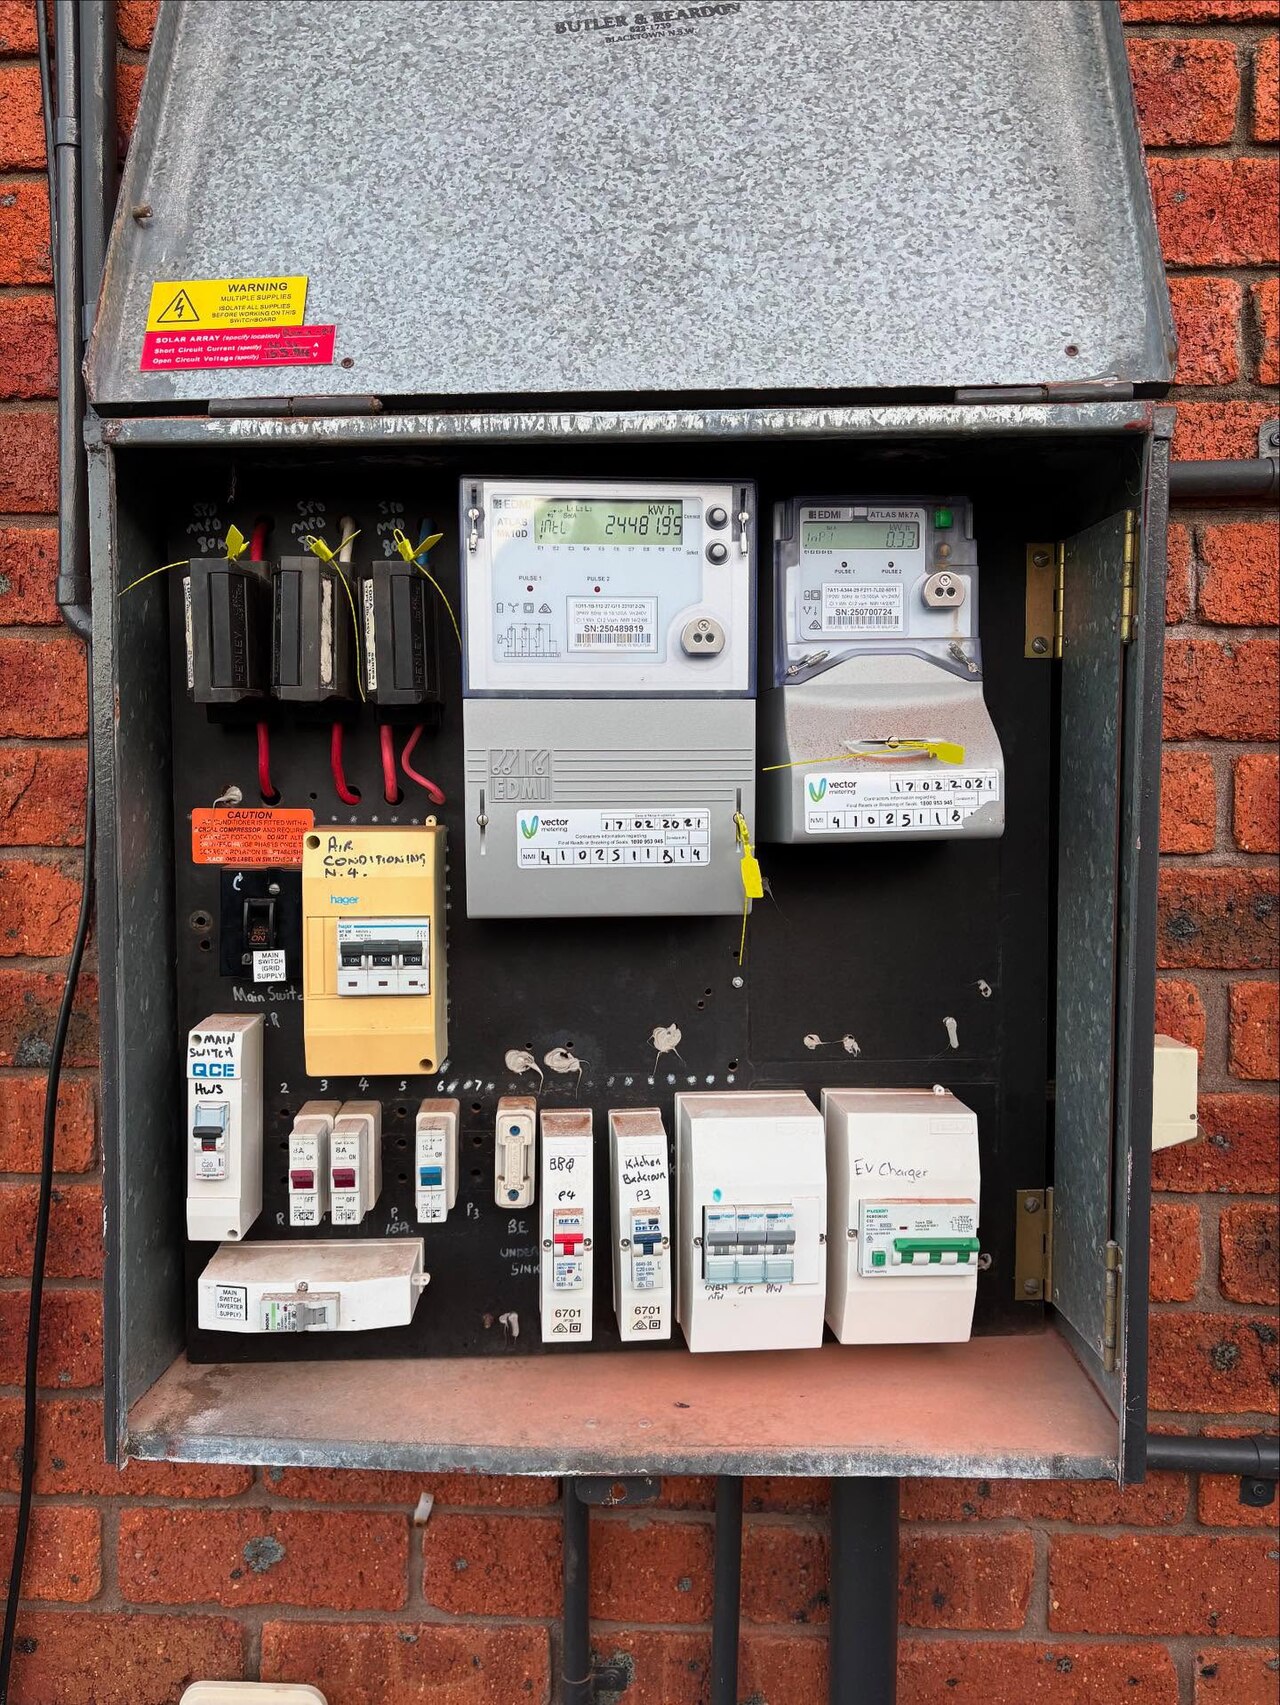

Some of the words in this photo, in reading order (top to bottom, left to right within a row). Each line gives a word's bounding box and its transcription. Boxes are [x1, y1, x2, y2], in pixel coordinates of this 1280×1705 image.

[554, 15, 629, 35] BUTLER
[635, 13, 649, 25] &
[653, 2, 741, 23] REARDON
[604, 30, 666, 44] BLACKTOWN
[228, 282, 288, 293] WARNING
[257, 293, 292, 301] SUPPLIES
[230, 316, 277, 324] SWITCHBOARD
[155, 336, 186, 344] SOLAR
[154, 346, 175, 355] Short
[178, 345, 203, 354] Circuit
[207, 344, 235, 352] Current
[152, 356, 172, 365] Open
[175, 355, 200, 363] Circuit
[203, 354, 234, 363] Voltage
[648, 505, 665, 516] kW
[818, 510, 841, 519] EDMI
[870, 511, 897, 519] ATLAS
[899, 511, 920, 519] Mk7A
[499, 778, 547, 800] EDMI
[829, 780, 858, 789] vector
[227, 811, 273, 819] CAUTION
[541, 819, 569, 827] vector
[328, 836, 353, 852] AIR
[323, 853, 426, 867] CONDITIONING
[330, 895, 359, 905] hager
[233, 986, 265, 1001] Main
[204, 1033, 235, 1044] MAIN
[190, 1047, 233, 1058] SWITCH
[193, 1063, 235, 1077] QCE
[195, 1083, 223, 1095] HWS
[280, 1082, 290, 1094] 2
[320, 1080, 328, 1092] 3
[359, 1077, 369, 1091] 4
[399, 1081, 407, 1091] 5
[437, 1081, 444, 1091] 6
[475, 1080, 483, 1091] 7
[550, 1157, 575, 1173] BBQ
[854, 1158, 874, 1176] EV
[878, 1162, 928, 1180] Charger
[636, 1189, 651, 1202] P3
[276, 1212, 285, 1226] R
[217, 1303, 243, 1311] (INVERTER
[634, 1306, 660, 1315] 6701
[219, 1311, 242, 1319] SUPPLY)
[555, 1309, 581, 1317] 6701
